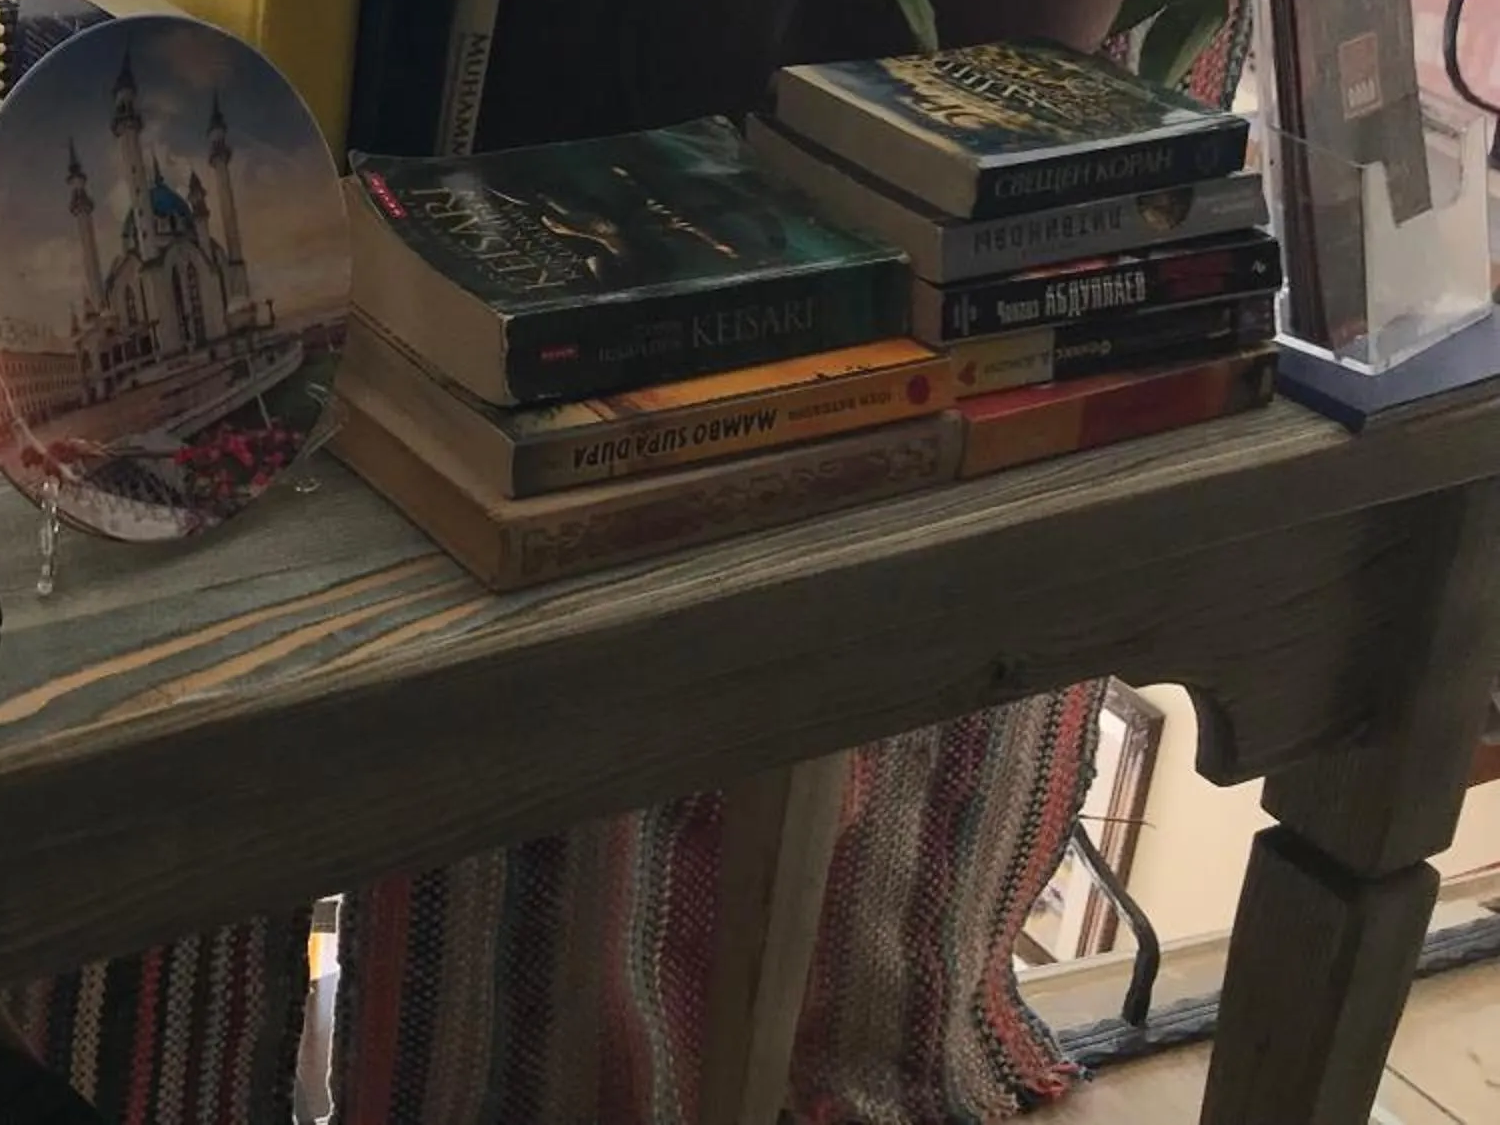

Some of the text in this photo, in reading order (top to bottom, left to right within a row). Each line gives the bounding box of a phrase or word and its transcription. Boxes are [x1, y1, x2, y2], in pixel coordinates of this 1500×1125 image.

[1096, 146, 1175, 183] КОРАН
[410, 186, 567, 291] KEISARI
[1045, 271, 1146, 318] АБДУЛЛАЕВ
[690, 299, 817, 350] KEISARI
[573, 407, 779, 468] MAMBO SUPA DUPA
